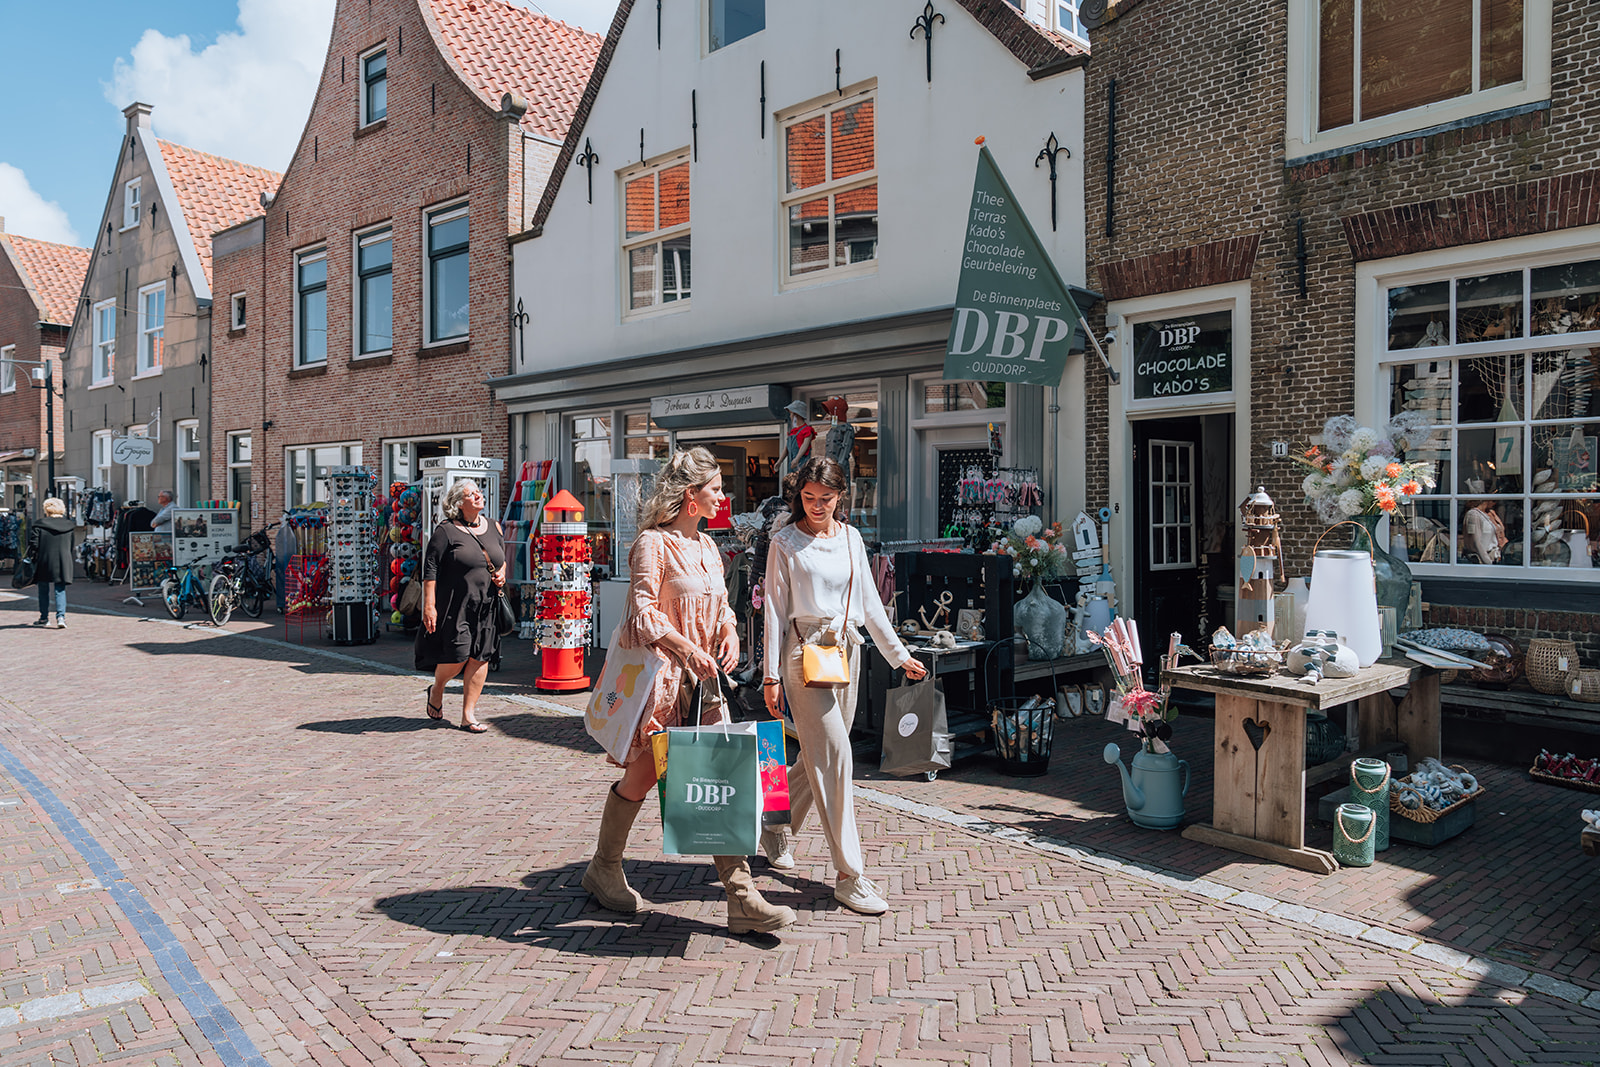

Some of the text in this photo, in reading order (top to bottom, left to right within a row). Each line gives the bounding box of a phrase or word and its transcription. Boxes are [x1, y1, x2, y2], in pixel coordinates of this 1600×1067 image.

[976, 191, 1004, 207] Thee
[973, 208, 1007, 224] Terras
[969, 224, 1006, 240] Kado's
[966, 240, 1026, 259] Chocolade
[963, 257, 1038, 280] Geurbeleving
[973, 290, 1061, 312] De Binnenplaets
[948, 307, 1069, 362] DBP
[1159, 326, 1201, 348] DBP
[972, 361, 1027, 376] OUDDORP
[1137, 353, 1227, 376] CHOCOLADE
[1153, 378, 1210, 396] KADO'S
[694, 398, 700, 410] &
[704, 394, 715, 410] La
[1276, 444, 1282, 454] 11
[1498, 436, 1514, 463] 7
[458, 460, 492, 469] OLYMPIC
[684, 784, 736, 805] DBP
